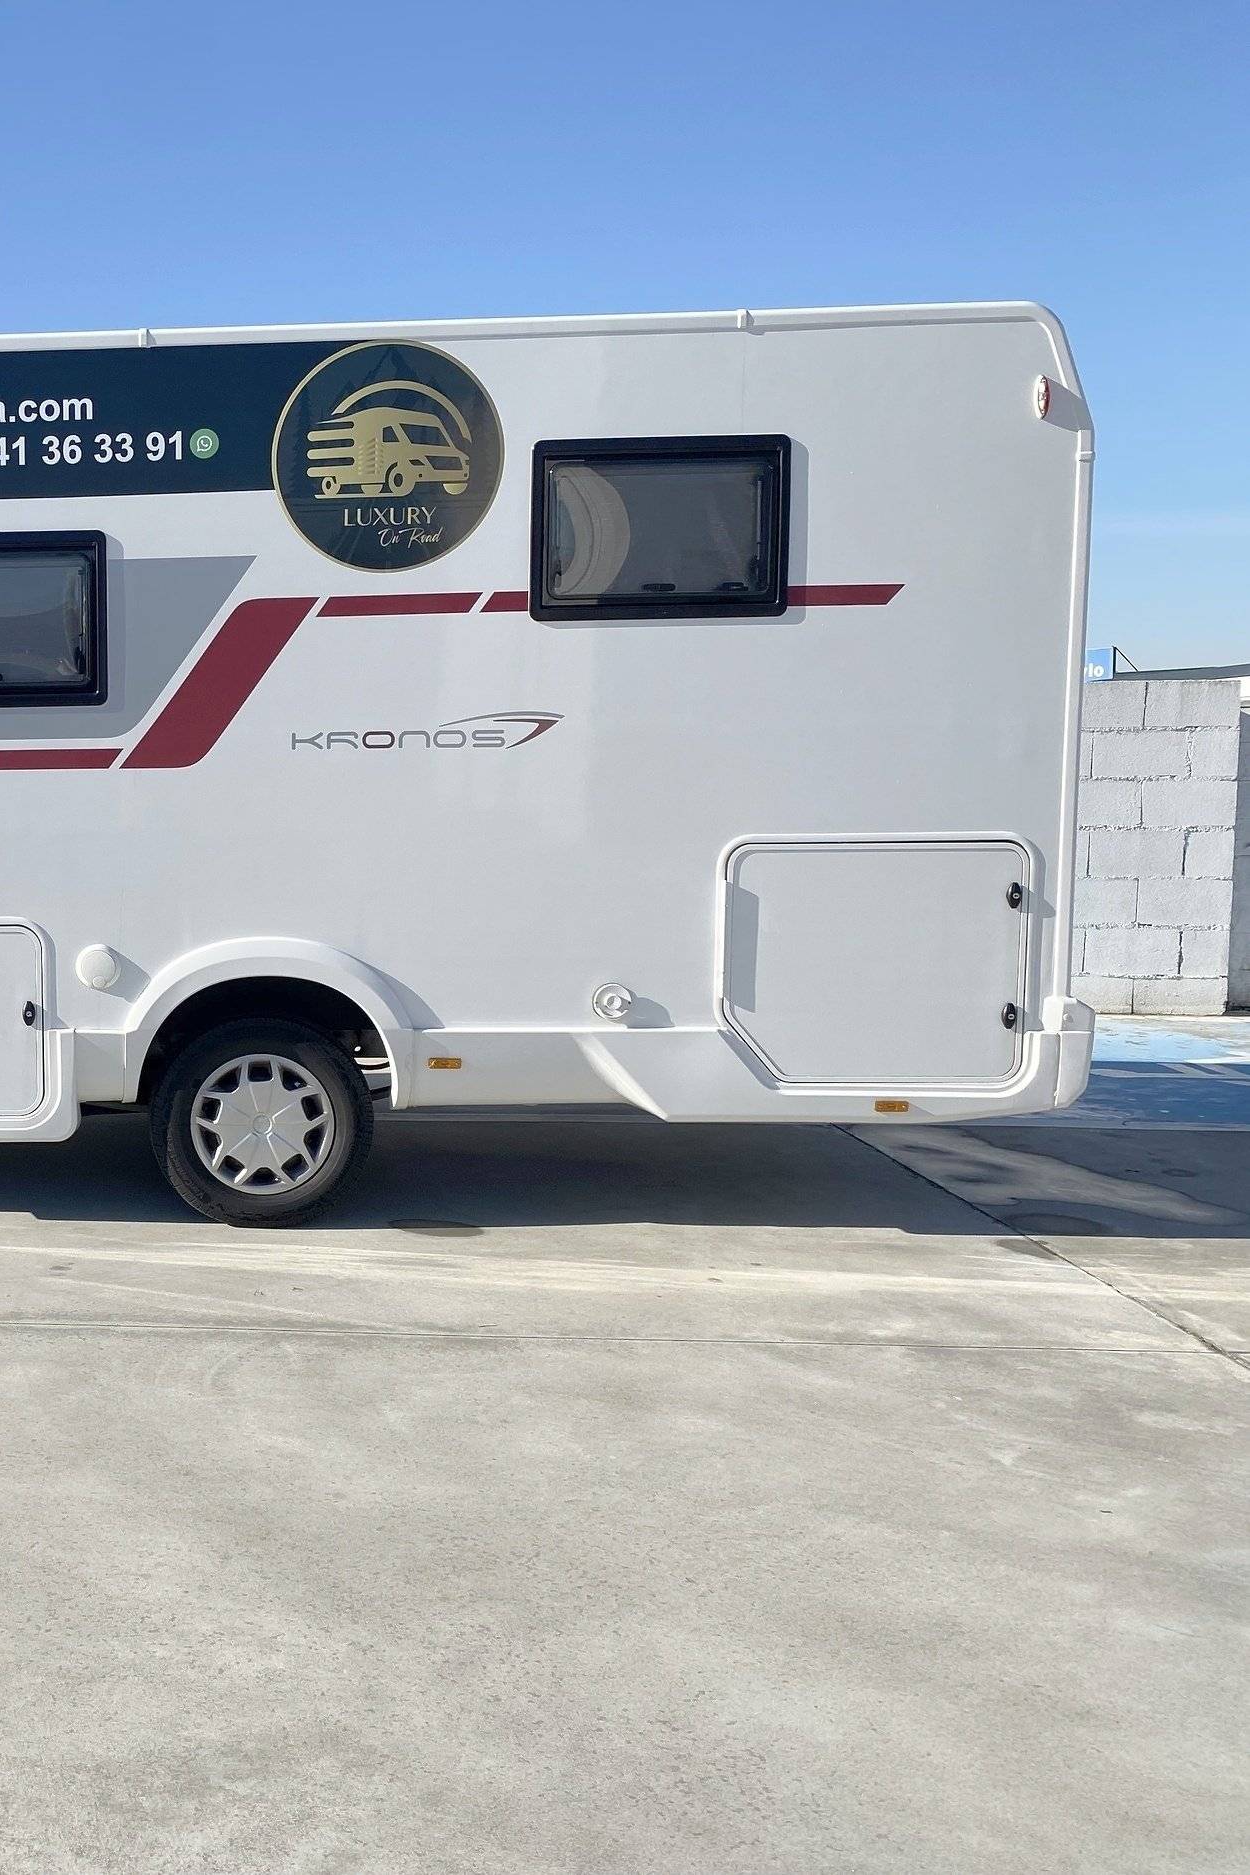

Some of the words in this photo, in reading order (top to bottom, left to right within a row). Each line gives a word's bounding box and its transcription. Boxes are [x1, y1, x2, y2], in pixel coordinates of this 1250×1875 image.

[42, 433, 81, 466] 36
[94, 432, 134, 464] 33
[146, 430, 184, 462] 91
[343, 507, 436, 526] LUXURY
[379, 529, 399, 546] On
[399, 527, 443, 548] Road
